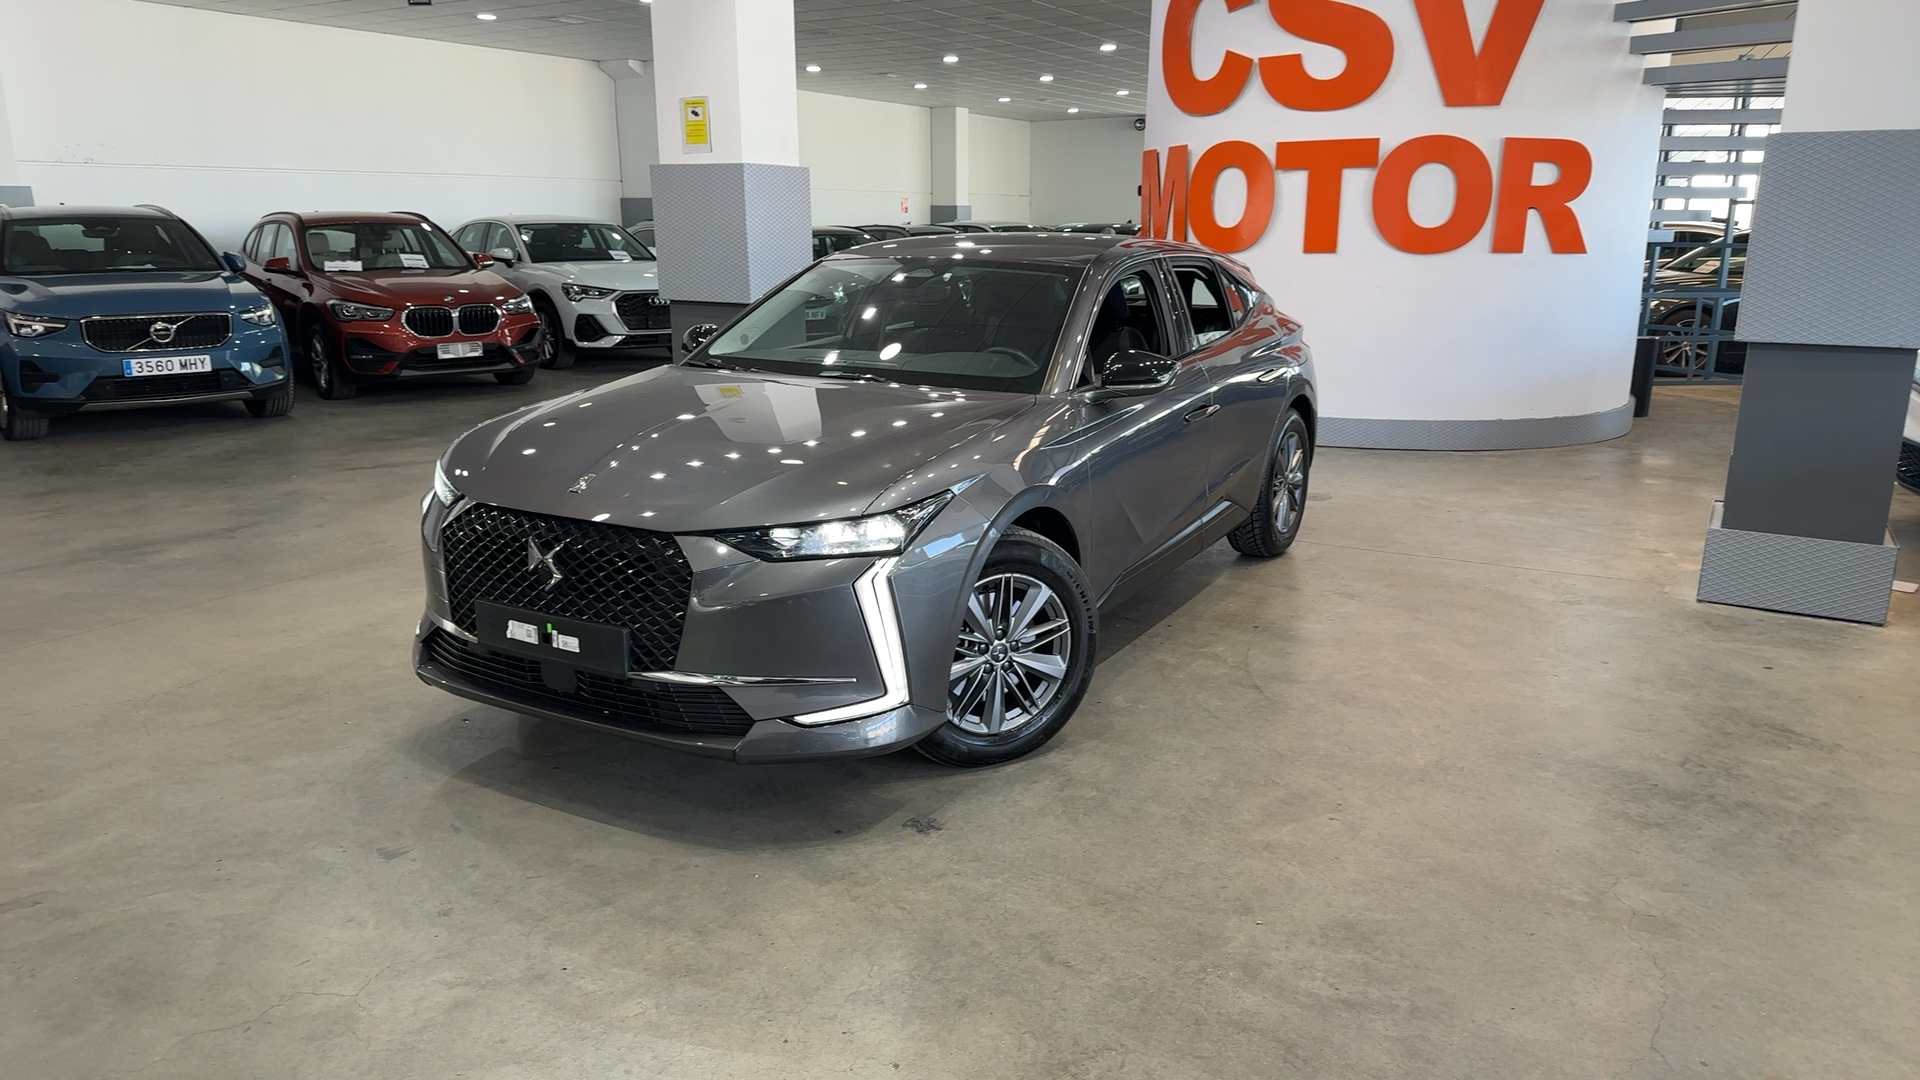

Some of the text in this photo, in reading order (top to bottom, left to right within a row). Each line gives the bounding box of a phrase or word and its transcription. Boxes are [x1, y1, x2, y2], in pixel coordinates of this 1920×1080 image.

[1162, 0, 1544, 115] CSV
[1141, 134, 1593, 254] MOTOR
[135, 357, 206, 373] 3560 MHY
